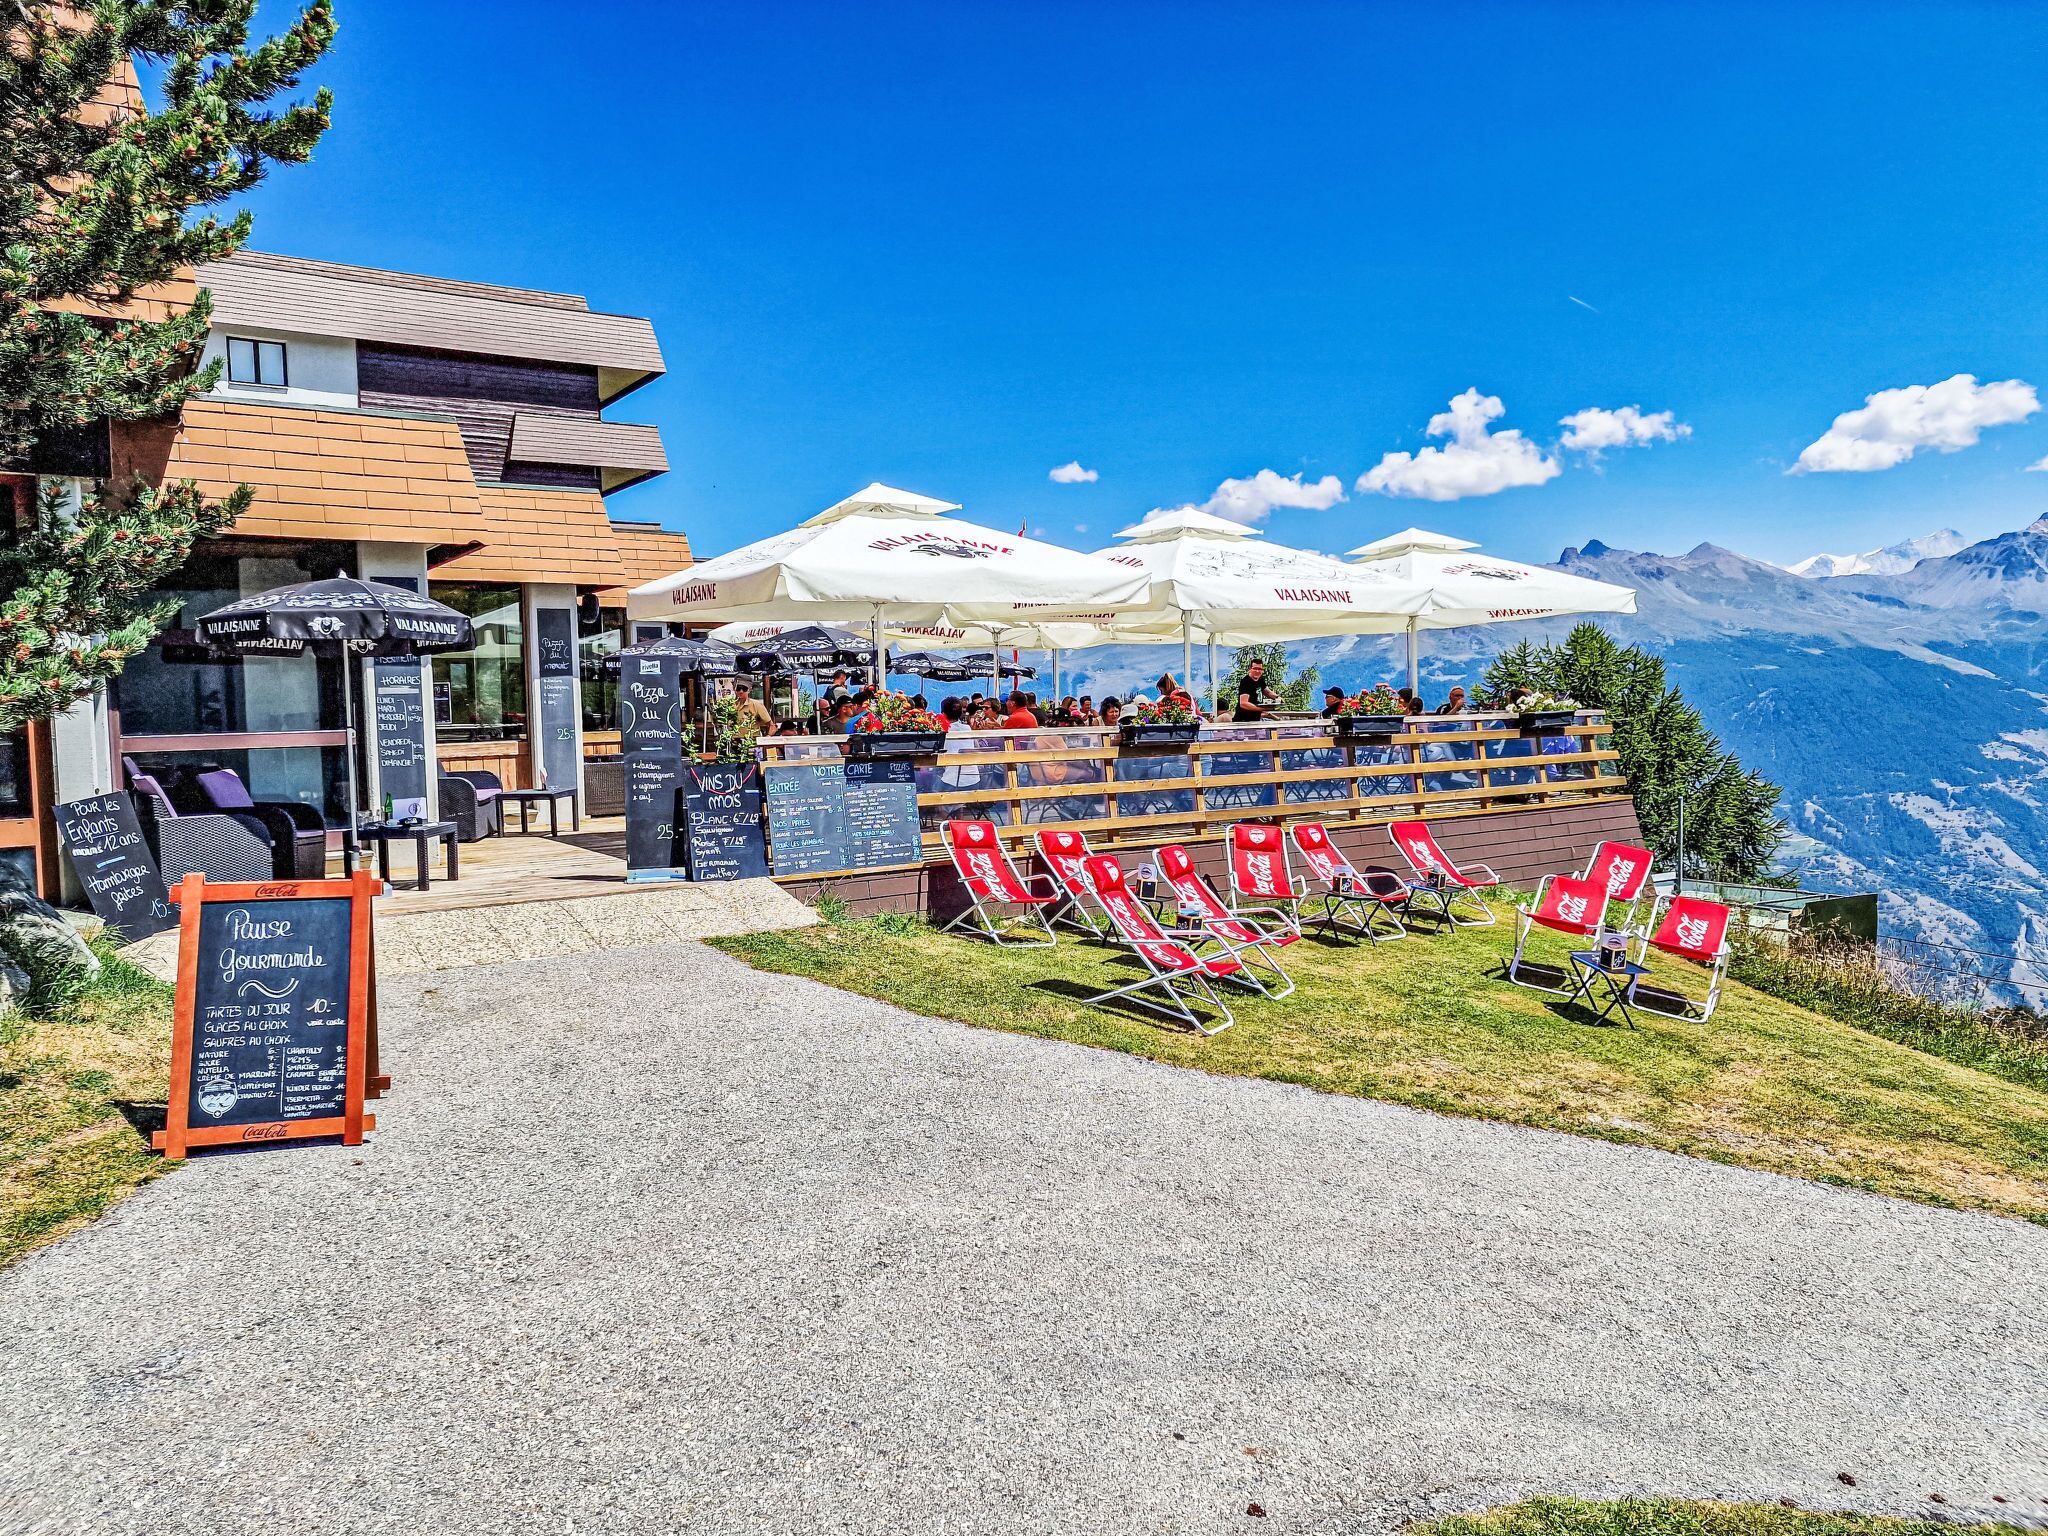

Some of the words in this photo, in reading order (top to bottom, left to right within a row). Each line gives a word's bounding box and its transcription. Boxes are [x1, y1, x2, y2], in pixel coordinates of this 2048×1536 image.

[868, 533, 1014, 555] VALAISANNE
[673, 583, 717, 605] VALAISANNE
[1276, 588, 1353, 604] VALAISANNE
[207, 620, 261, 634] VALAISANNE
[394, 618, 458, 635] VALAISANNE
[784, 655, 833, 664] VALAISANNE
[642, 663, 659, 671] rivella
[380, 674, 421, 686] HORAIRES
[630, 682, 669, 704] Pizza
[642, 707, 661, 720] du
[813, 766, 844, 777] NOTRE
[847, 763, 873, 775] CARTE
[768, 777, 800, 793] ENTRÉE
[65, 815, 120, 843] Enfants
[225, 909, 294, 941] Pause
[205, 1005, 242, 1018] TARTES
[247, 1006, 260, 1016] DU
[263, 1003, 291, 1015] JOUR
[204, 1021, 240, 1033] GLACES
[244, 1021, 257, 1031] AU
[259, 1020, 288, 1031] CHOIX
[203, 1037, 246, 1048] GAUFRES
[249, 1036, 261, 1046] AU
[286, 1047, 323, 1055] CHANTILLY
[197, 1066, 230, 1075] NUTELLA
[286, 1063, 320, 1071] SMARTIES
[285, 1071, 316, 1079] CARAMEL
[286, 1084, 310, 1092] KINDER
